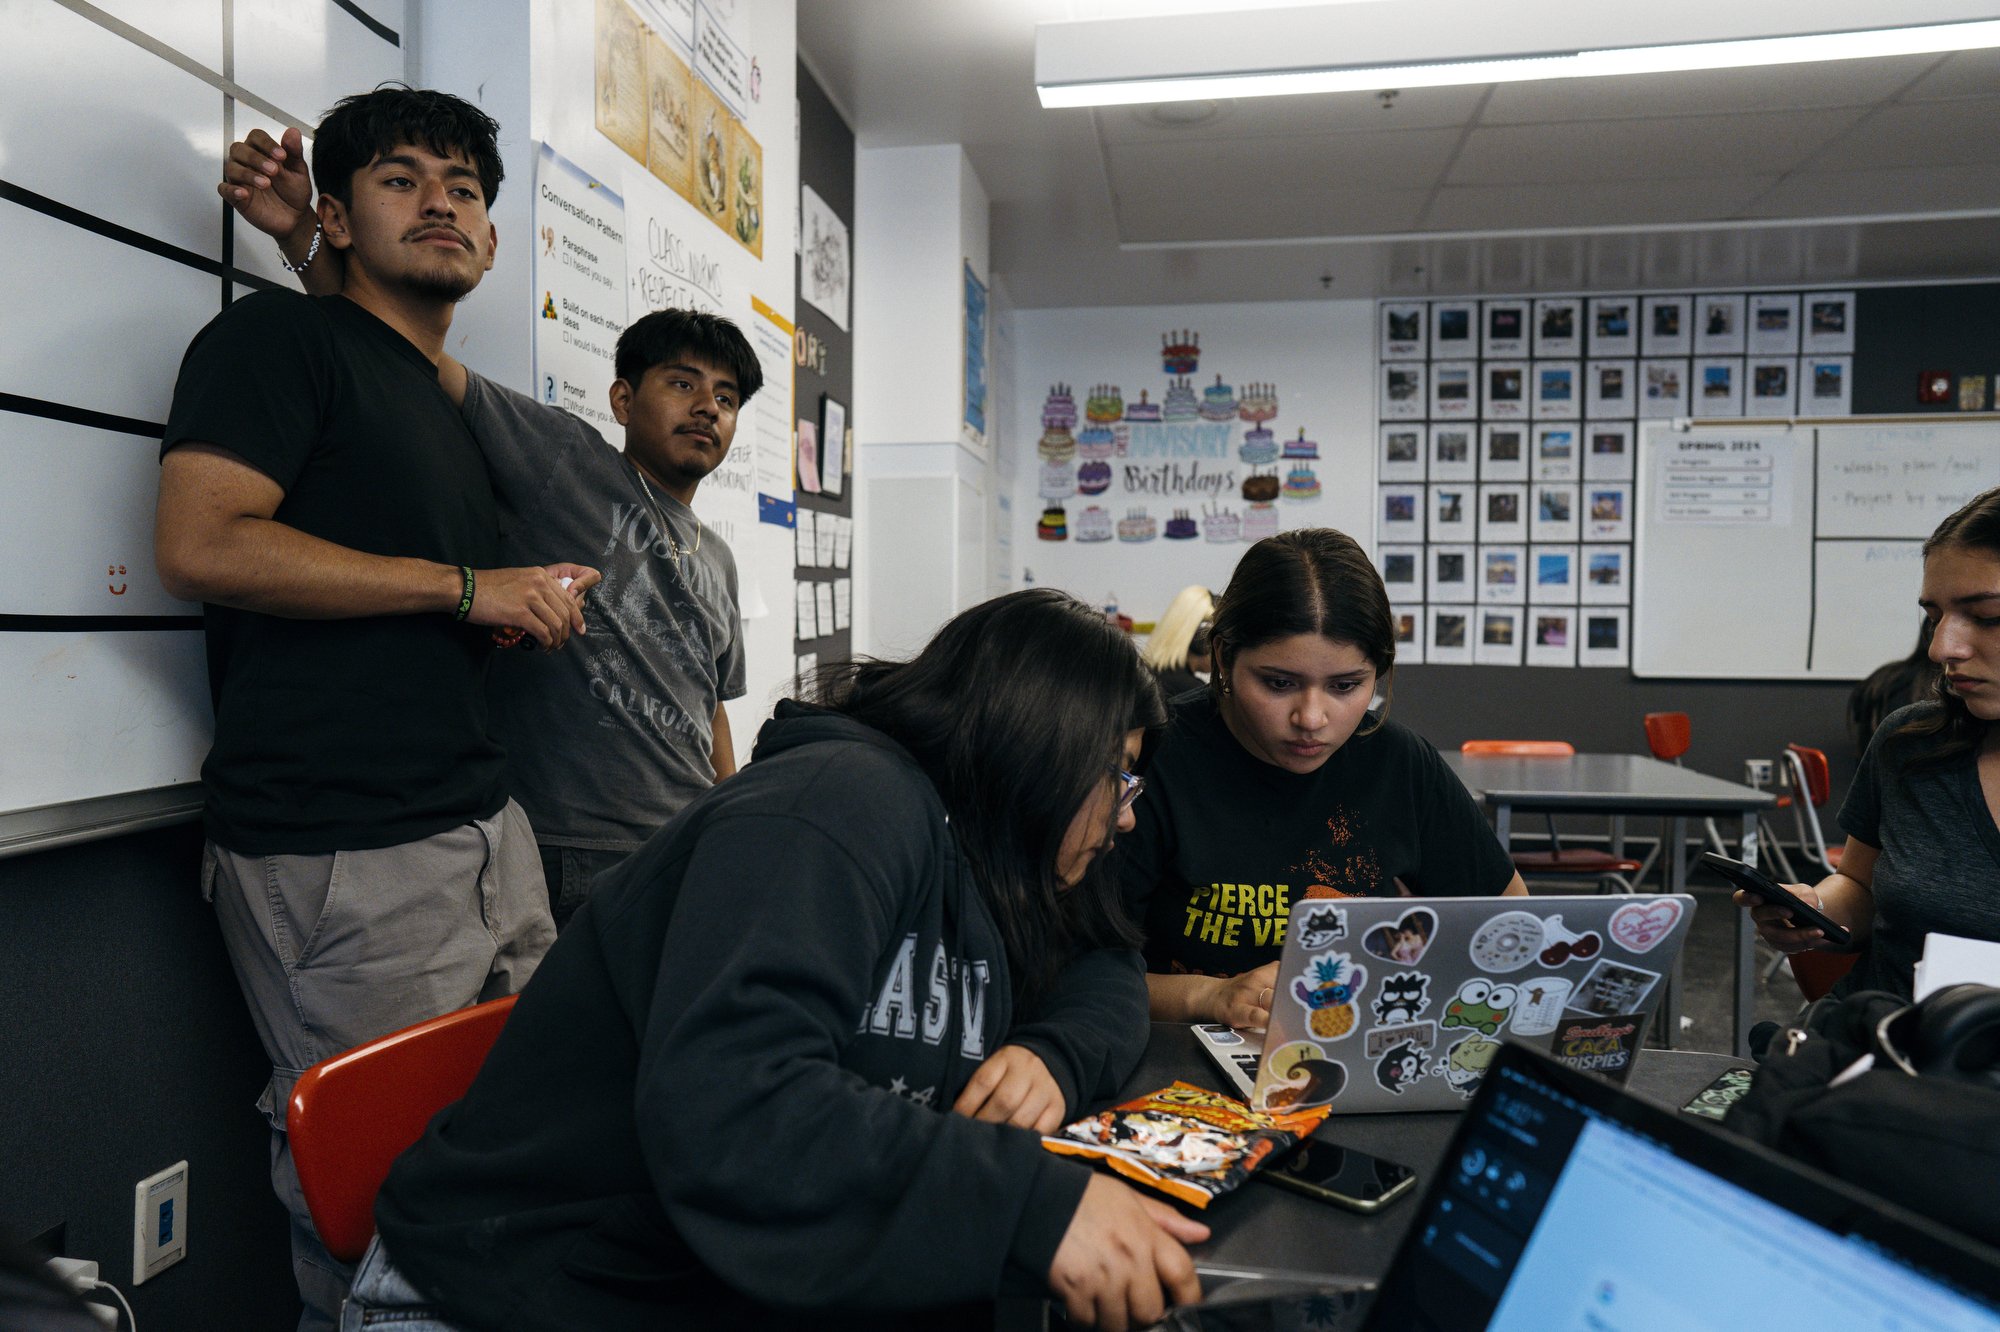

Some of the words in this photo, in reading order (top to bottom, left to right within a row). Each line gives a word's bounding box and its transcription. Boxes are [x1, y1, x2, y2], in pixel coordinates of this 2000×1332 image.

[541, 184, 595, 228] Conversation
[597, 218, 623, 245] Pattern
[562, 235, 598, 264] Paraphrase
[648, 217, 685, 273] CLASS
[573, 258, 591, 277] heard
[591, 271, 602, 282] you
[563, 298, 579, 314] Build
[580, 309, 589, 319] on
[589, 313, 604, 327] each
[563, 314, 579, 331] ideas
[573, 337, 590, 352] would
[591, 344, 601, 356] like
[602, 348, 608, 358] to
[563, 381, 586, 399] Prompt
[570, 400, 584, 415] What
[585, 407, 596, 417] can
[597, 412, 608, 422] you
[1679, 441, 1725, 450] SPRING
[1124, 460, 1234, 497] Birthdays
[1189, 883, 1290, 917] PIERCE
[1183, 906, 1243, 947] THE
[1565, 1037, 1620, 1057] CACA
